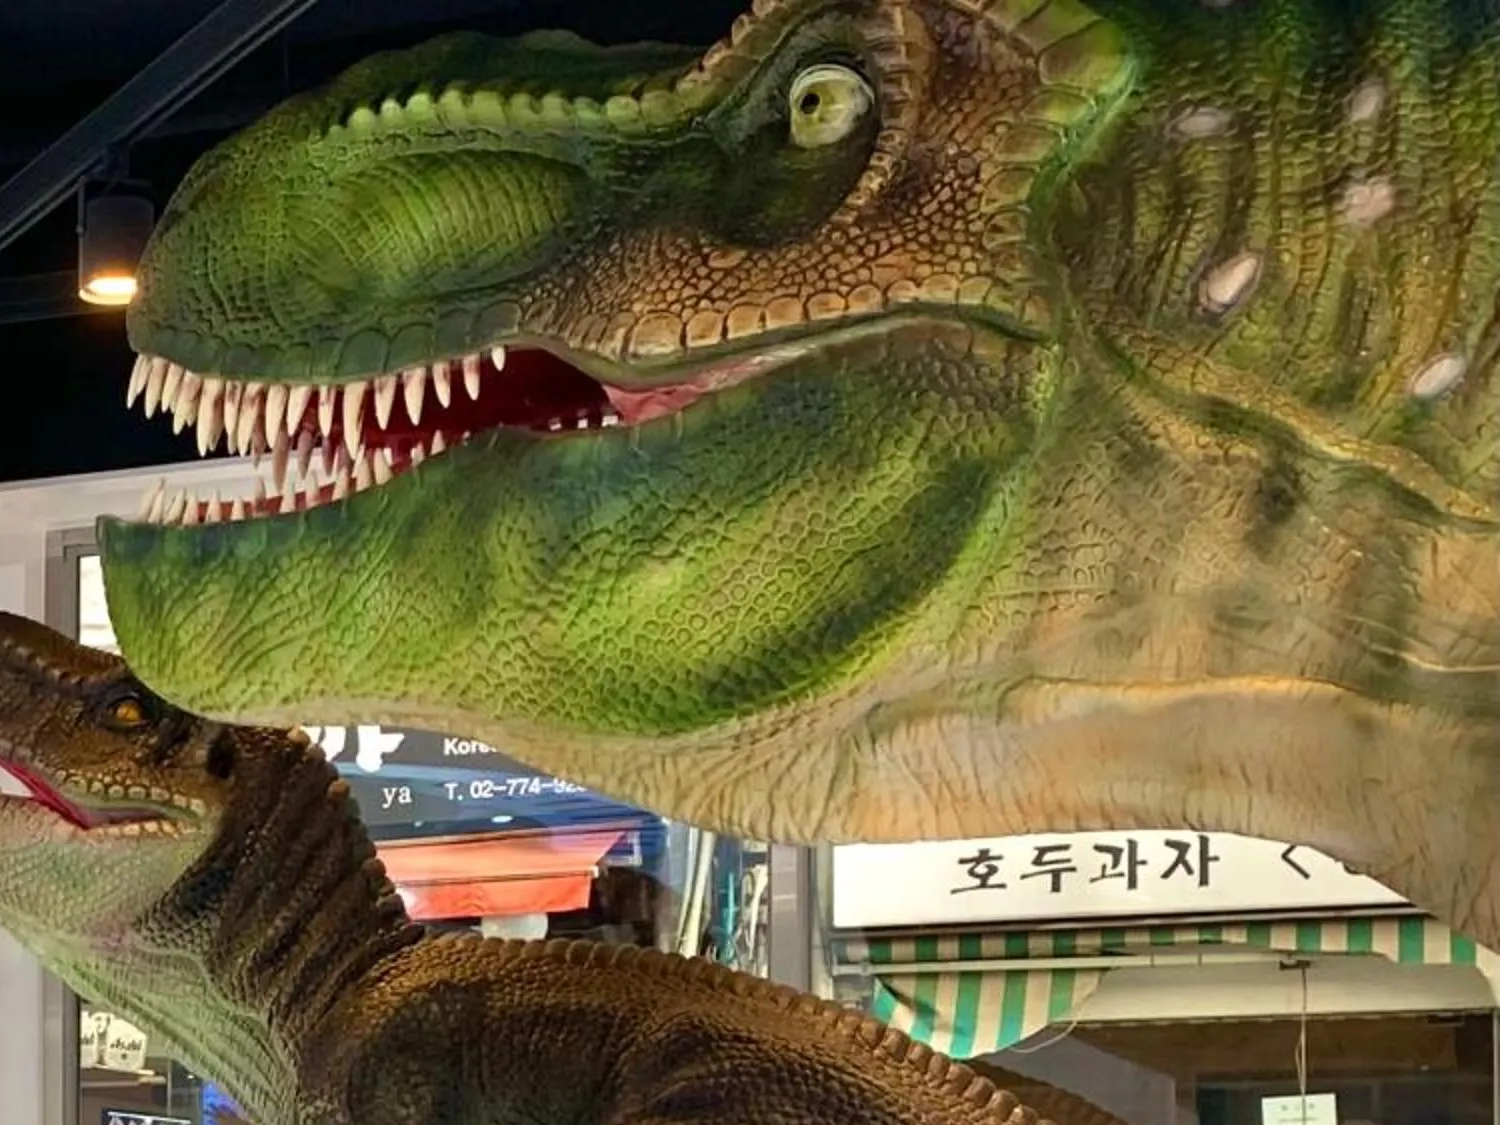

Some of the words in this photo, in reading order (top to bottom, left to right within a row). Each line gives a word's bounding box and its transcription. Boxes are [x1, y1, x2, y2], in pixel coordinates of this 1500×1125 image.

[443, 737, 497, 756] Kore
[381, 783, 412, 808] ya
[444, 782, 463, 801] T.
[950, 834, 1221, 895] 호두과자
